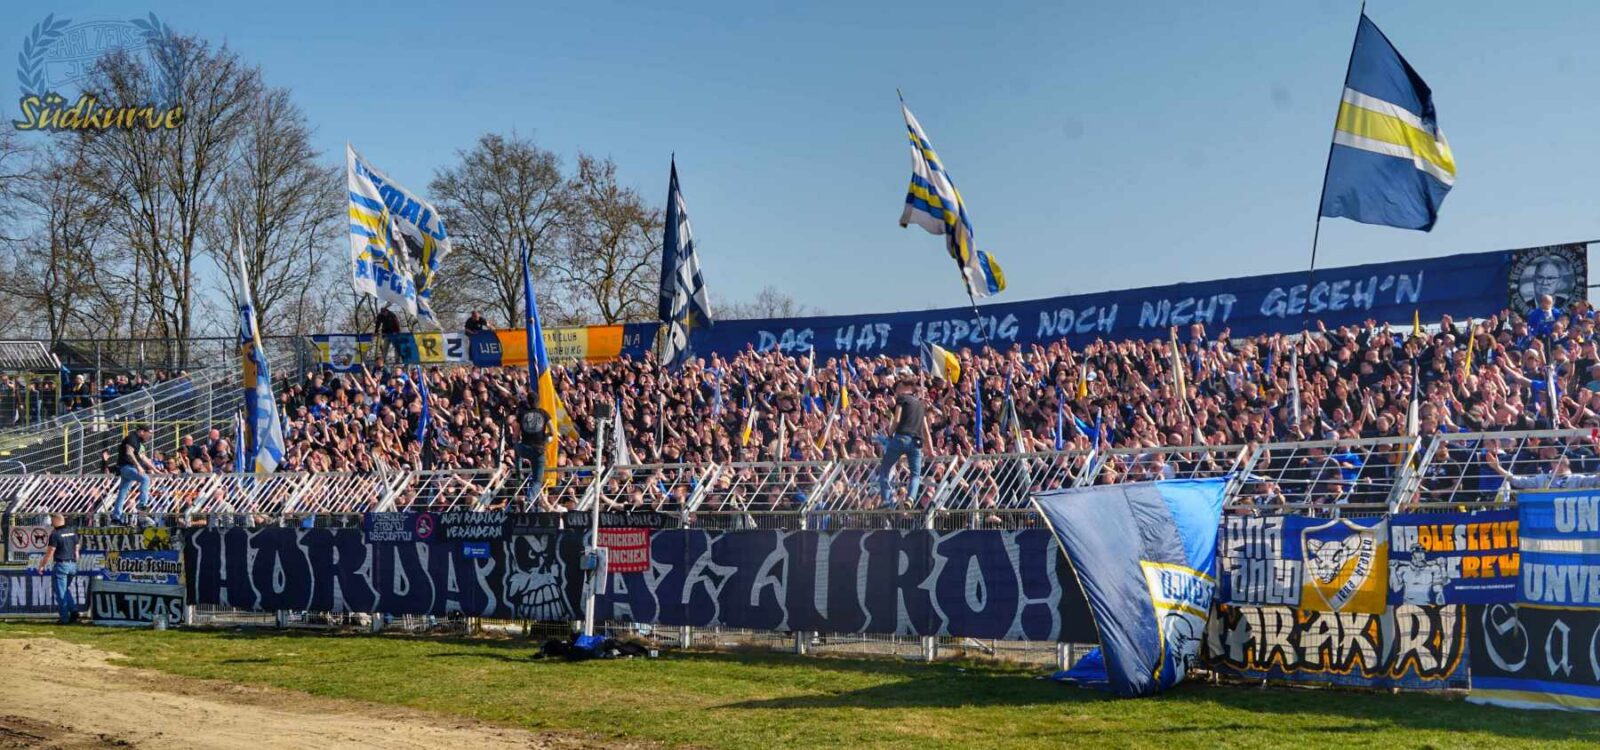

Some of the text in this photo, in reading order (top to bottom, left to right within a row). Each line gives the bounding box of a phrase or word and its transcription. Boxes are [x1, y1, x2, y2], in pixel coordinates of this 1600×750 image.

[758, 270, 1424, 353] DAS HAT LEIPZIG NOCH NICHT GESEH'N
[193, 527, 499, 616] HORDA
[608, 549, 647, 564] NCHEN
[95, 593, 183, 623] ULTRAS
